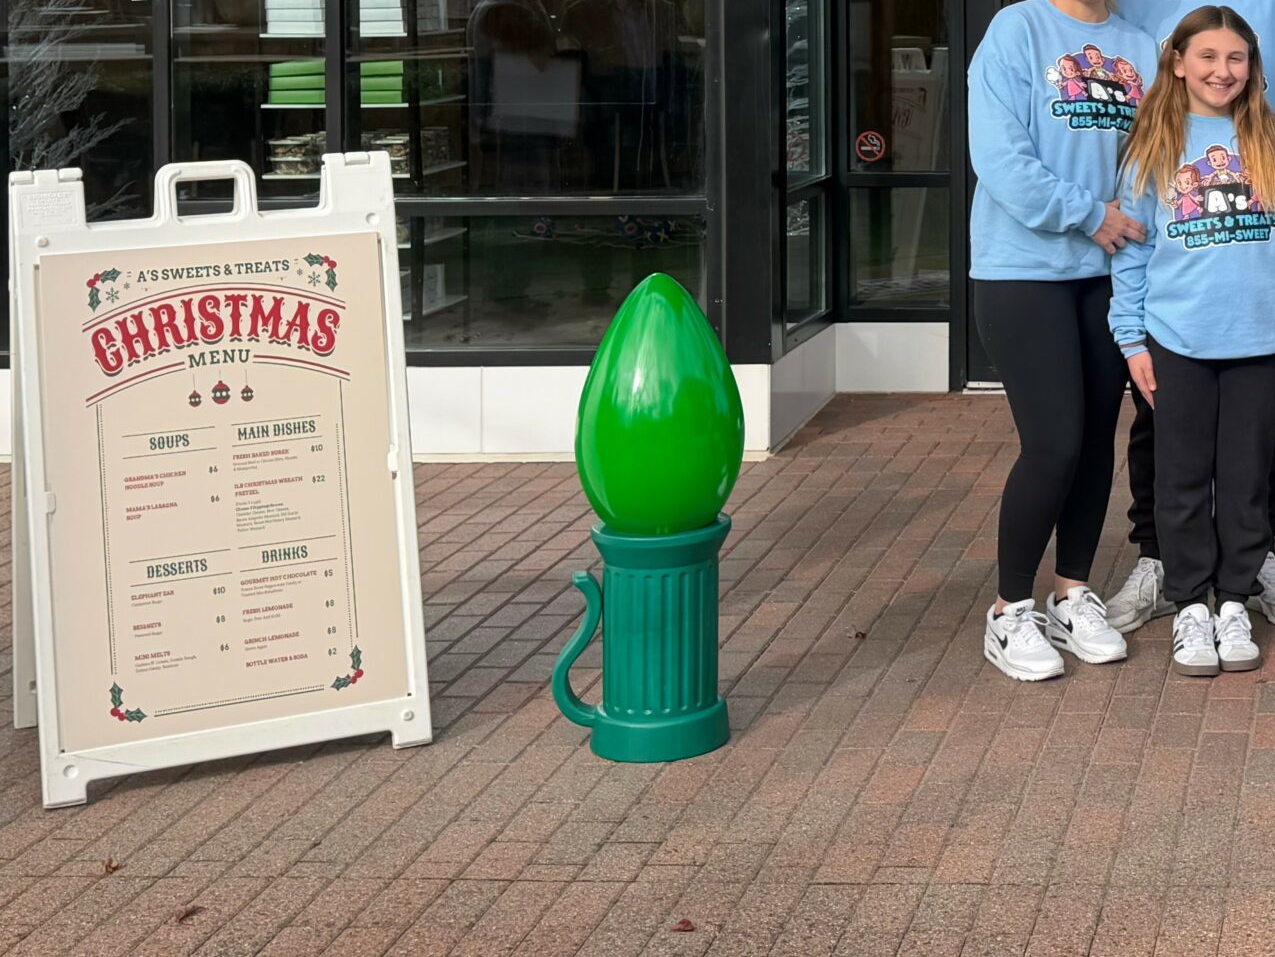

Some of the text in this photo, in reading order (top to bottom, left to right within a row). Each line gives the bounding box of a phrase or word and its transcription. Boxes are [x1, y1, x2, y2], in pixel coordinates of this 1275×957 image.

[1053, 102, 1137, 117] SWEETS & TRE
[1208, 190, 1248, 213] A's
[1168, 217, 1223, 236] SWEETS
[1224, 215, 1234, 227] &
[1186, 228, 1269, 247] 855-MI-SWEET
[137, 259, 290, 283] A'S SWEETS & TREATS
[91, 294, 340, 374] CHRISTMAS
[188, 349, 251, 368] MENU
[237, 420, 316, 441] MAIN DISHES
[149, 433, 190, 451] SOUPS
[311, 444, 323, 452] $10
[312, 475, 326, 484] $22
[262, 545, 308, 563] DRINKS
[146, 558, 208, 579] DESSERTS
[324, 569, 333, 578] $5
[213, 586, 226, 595] $10
[328, 647, 337, 657] $2
